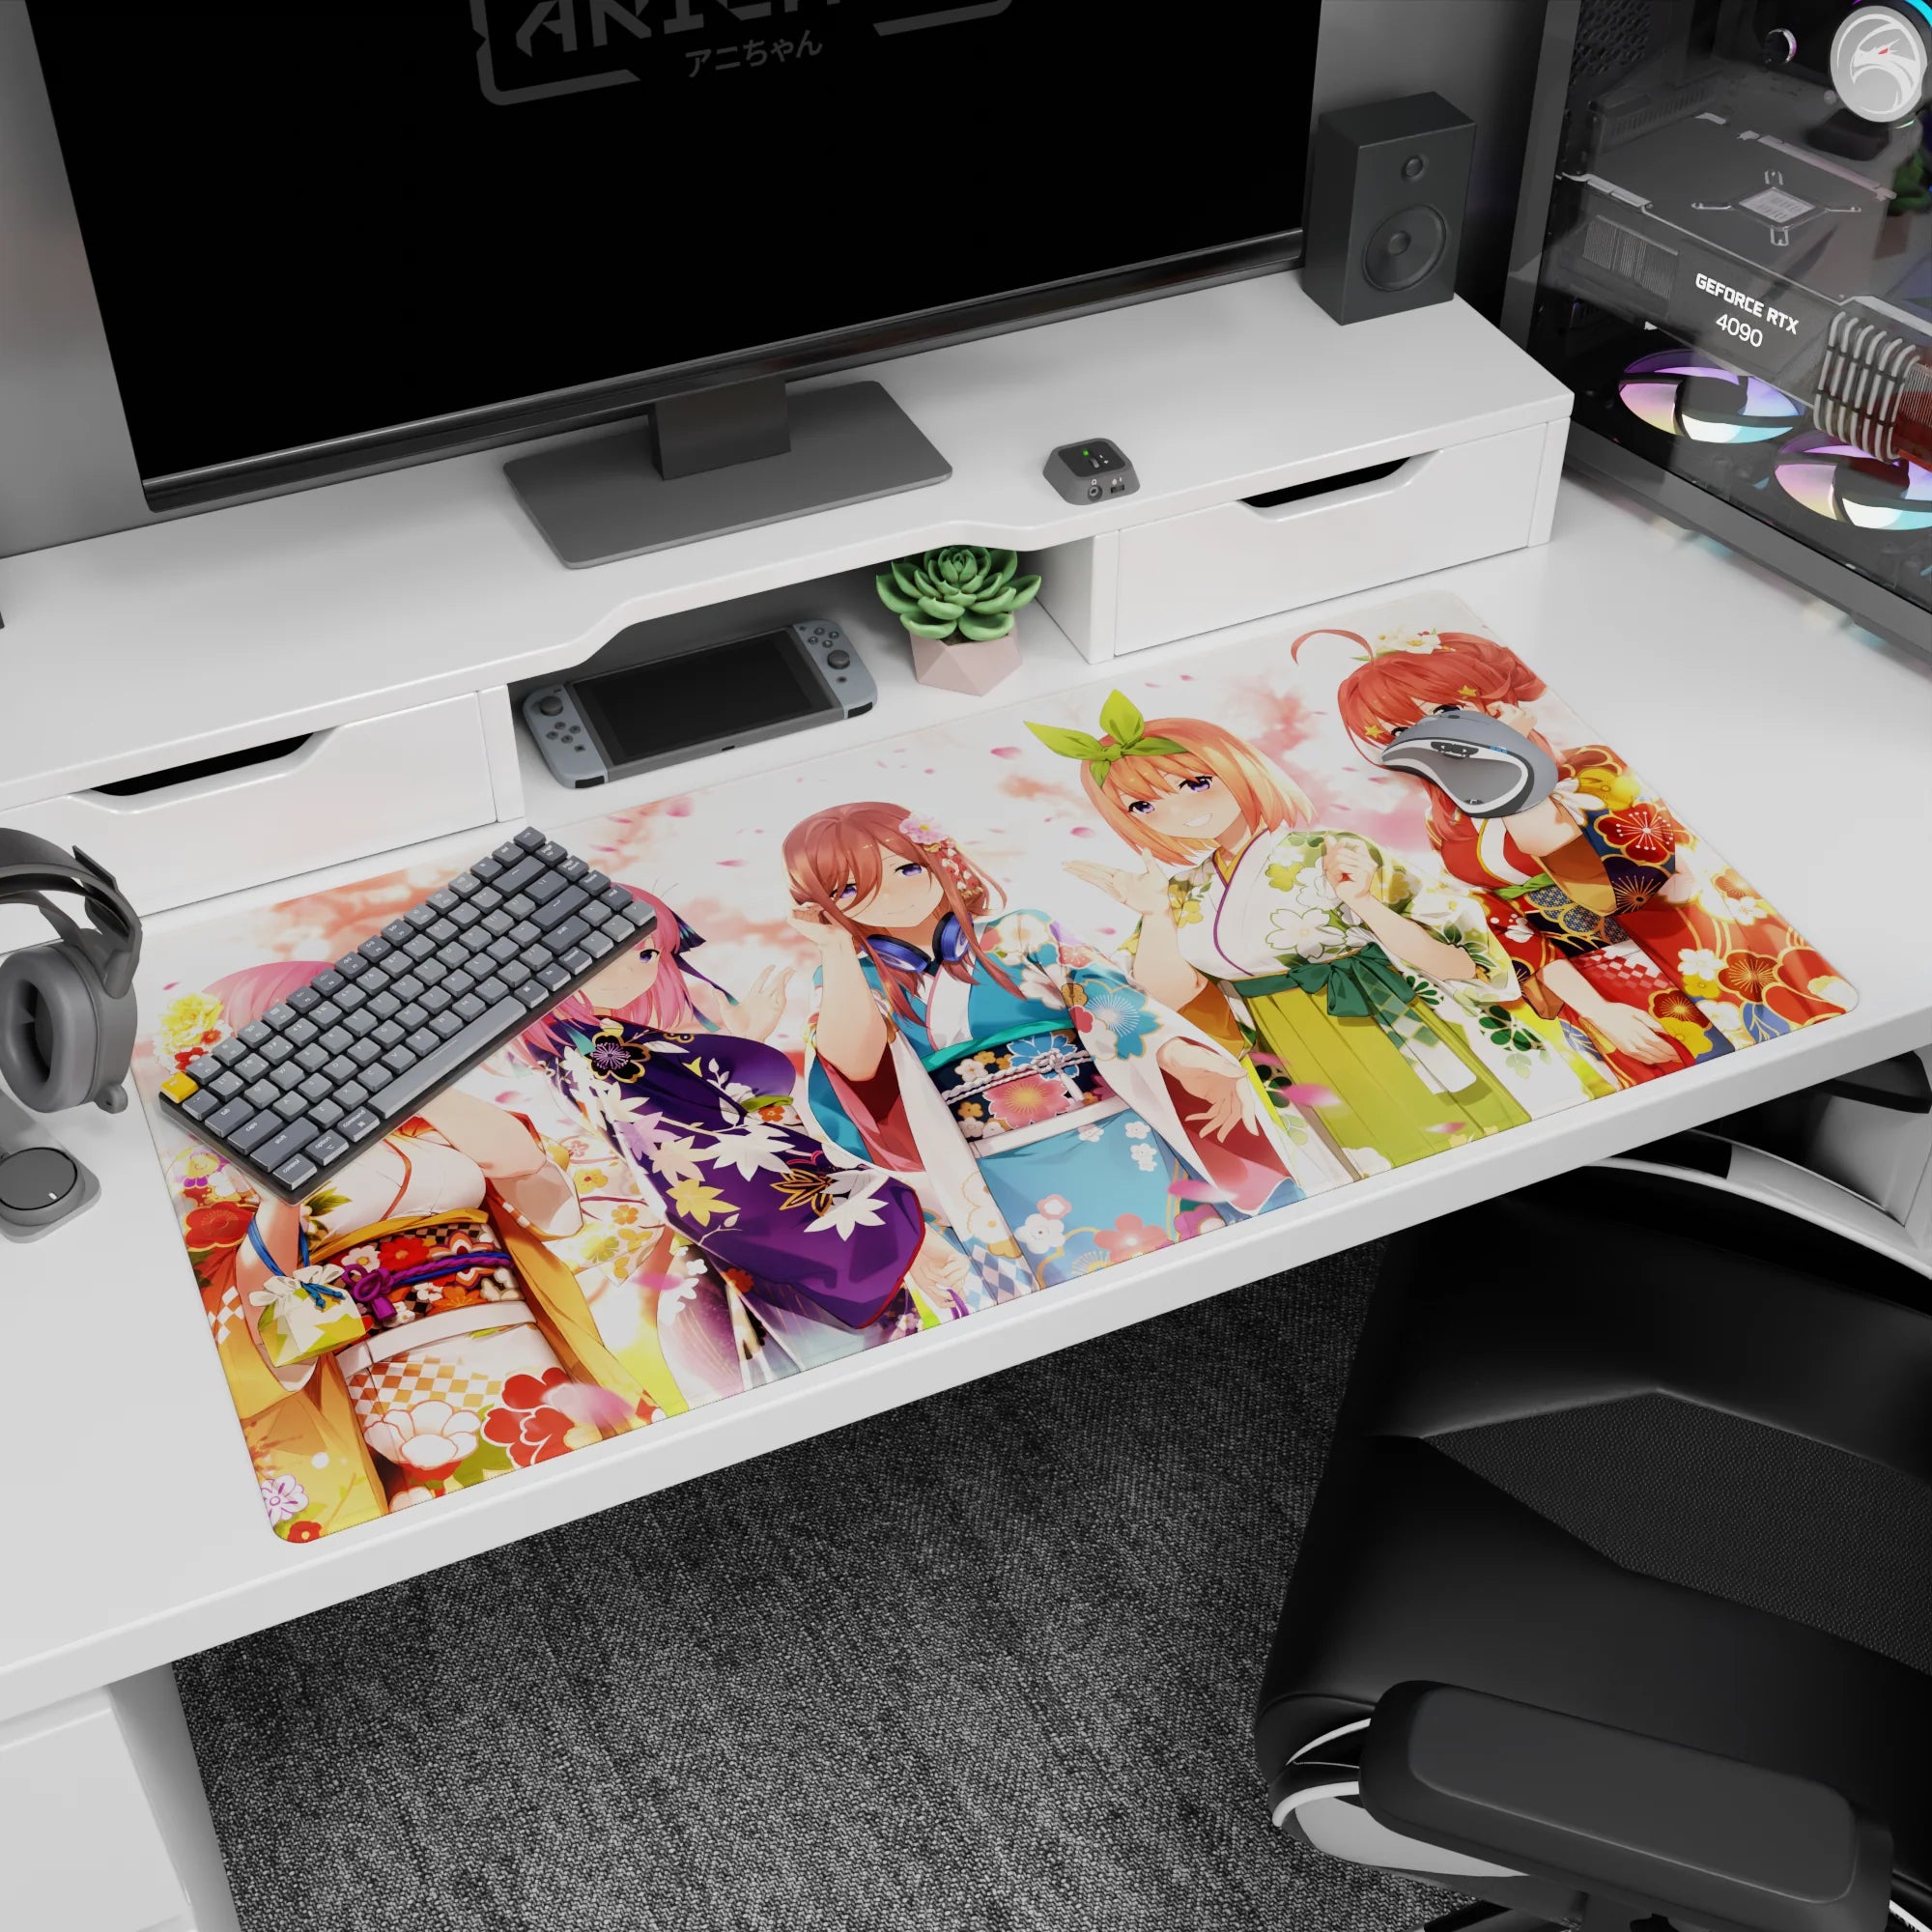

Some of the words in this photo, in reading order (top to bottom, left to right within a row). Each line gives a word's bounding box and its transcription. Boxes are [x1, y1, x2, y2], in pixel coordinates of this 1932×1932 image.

[685, 29, 823, 78] アニちゃん
[1695, 272, 1765, 318] GEFORCE
[1766, 306, 1800, 335] RTX
[1715, 313, 1764, 348] 4090
[557, 926, 568, 935] shift
[564, 950, 579, 961] control
[343, 1109, 366, 1128] command
[245, 1122, 258, 1132] caps
[274, 1134, 287, 1145] shift
[315, 1136, 331, 1149] option
[282, 1158, 300, 1174] control
